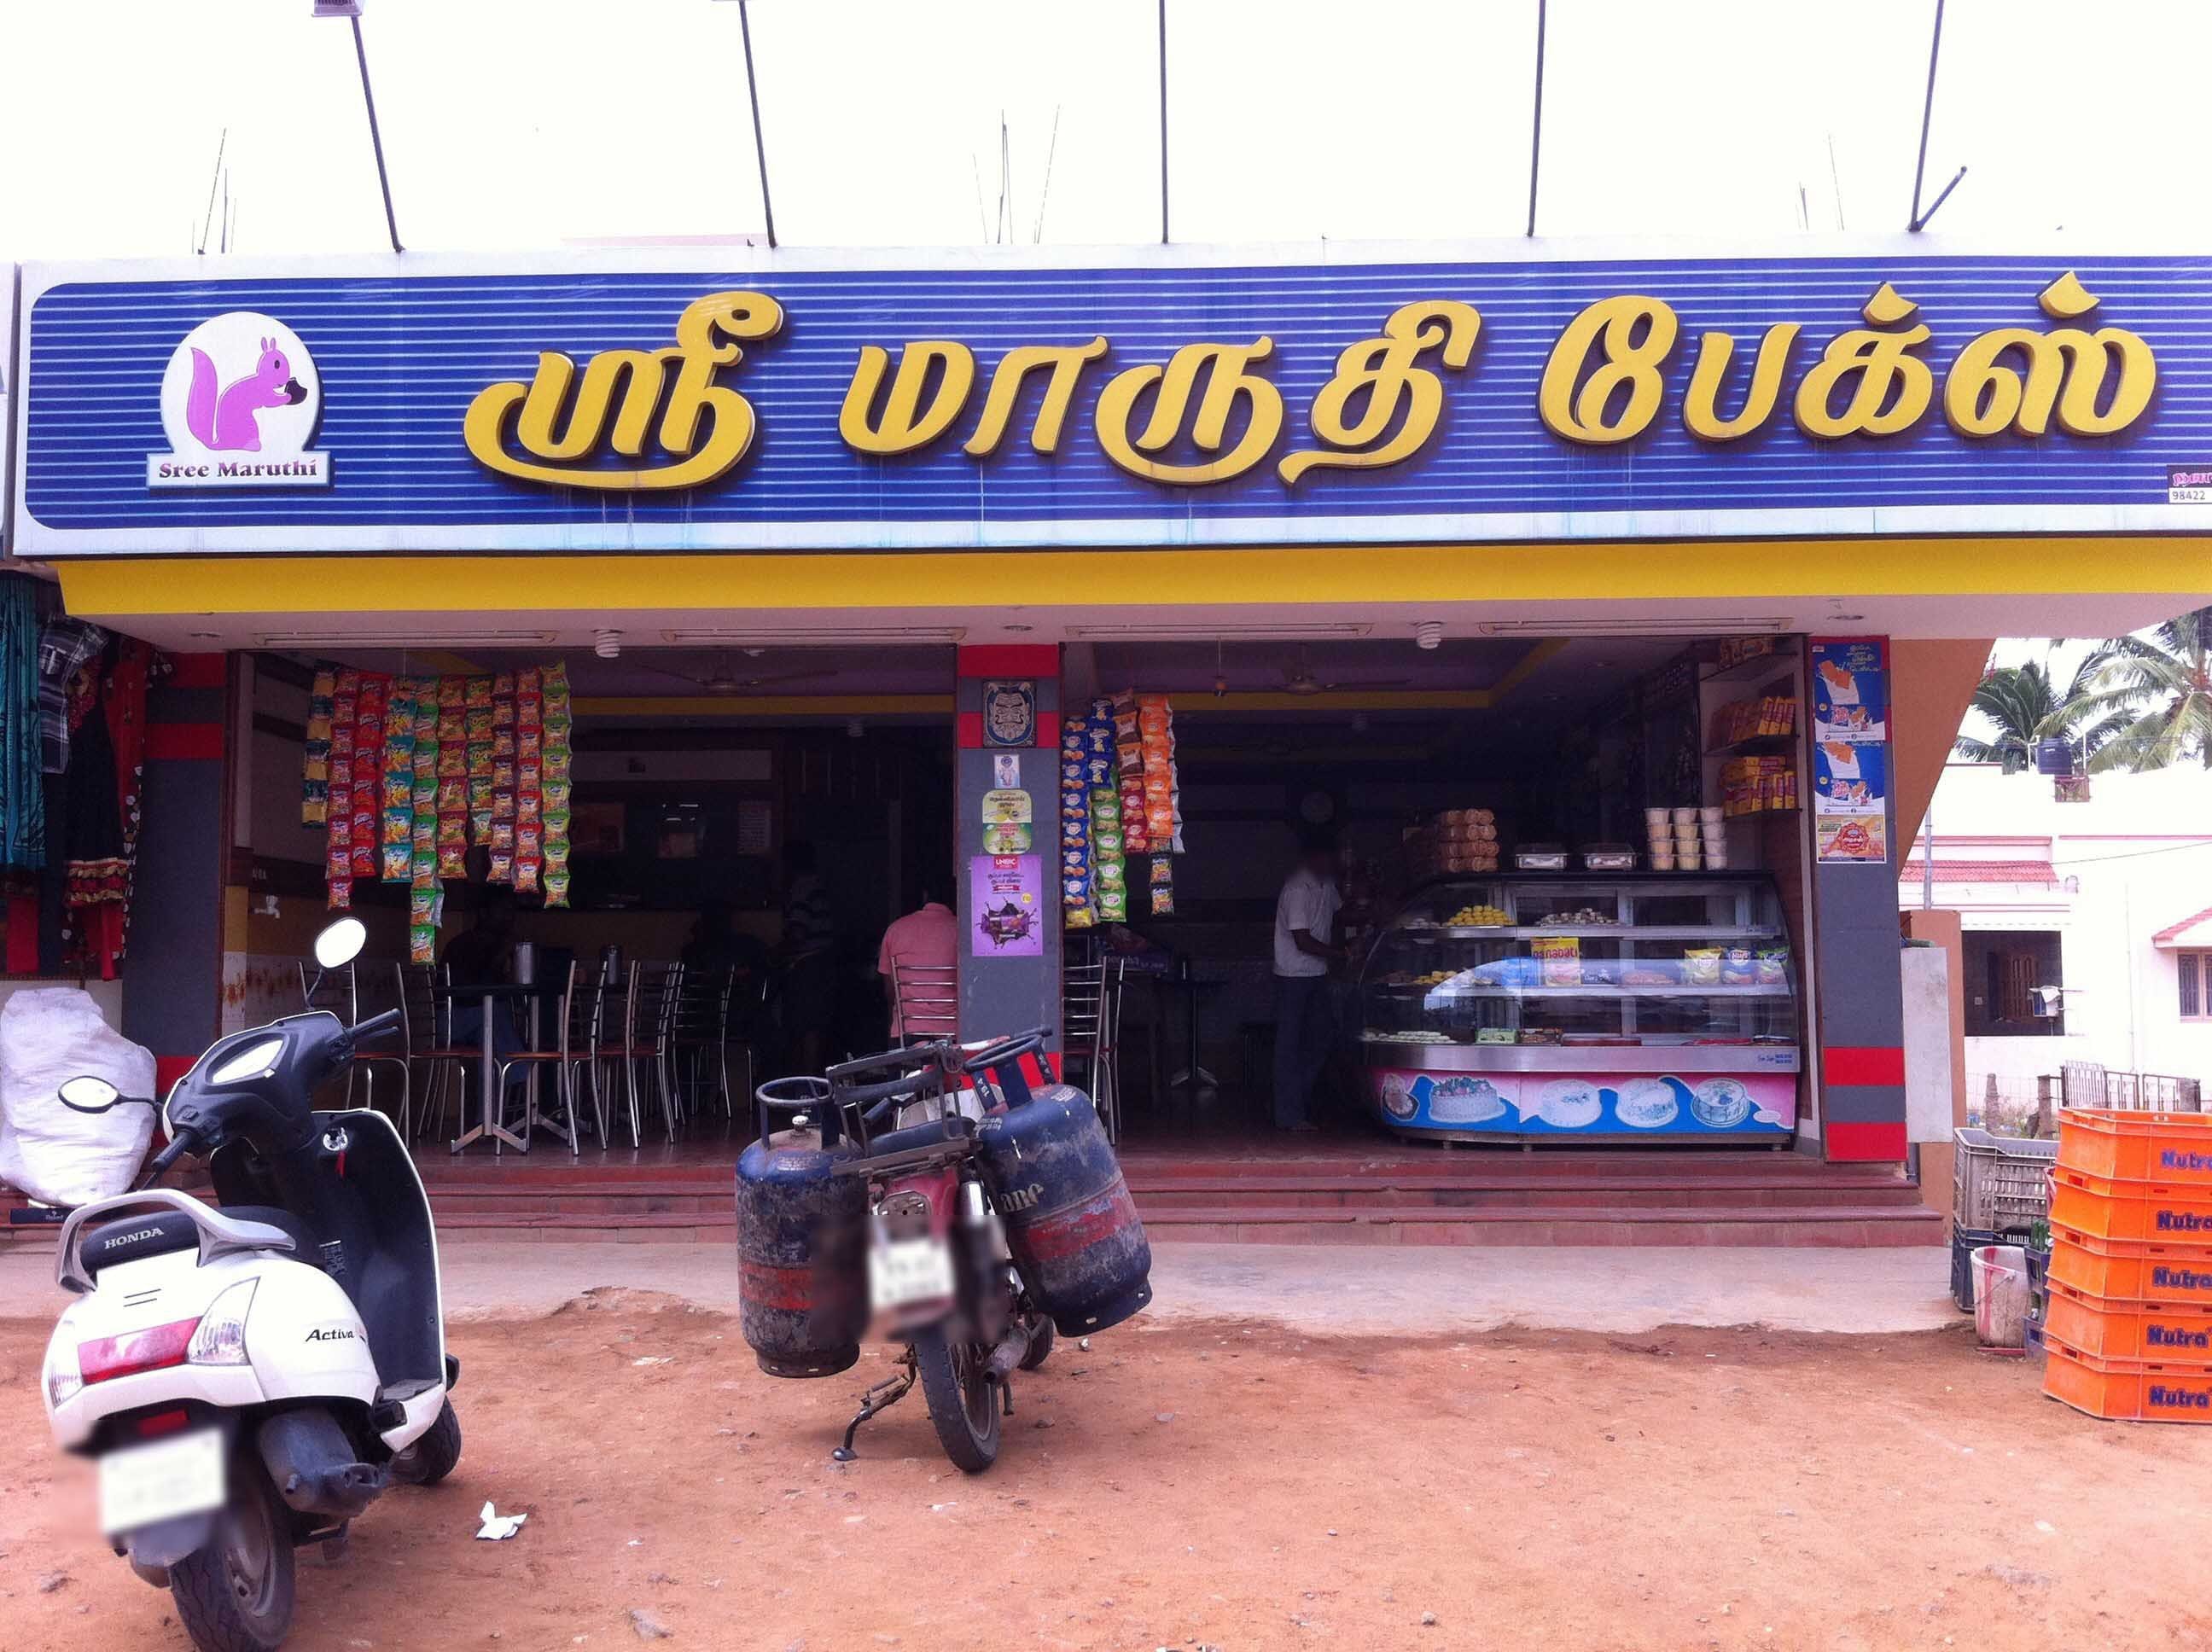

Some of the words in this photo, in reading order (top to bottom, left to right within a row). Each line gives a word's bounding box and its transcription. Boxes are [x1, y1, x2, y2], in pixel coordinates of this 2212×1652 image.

[838, 300, 1482, 486] மாருதி
[1539, 270, 2157, 444] பேக்ஸ்
[159, 462, 209, 478] Sree
[217, 459, 317, 477] Maruthi
[104, 1227, 164, 1249] HONDA
[2152, 1266, 2212, 1289] Nutra
[305, 1329, 355, 1342] Activa
[2146, 1324, 2209, 1348] Nutra
[2149, 1385, 2209, 1409] Nutra
